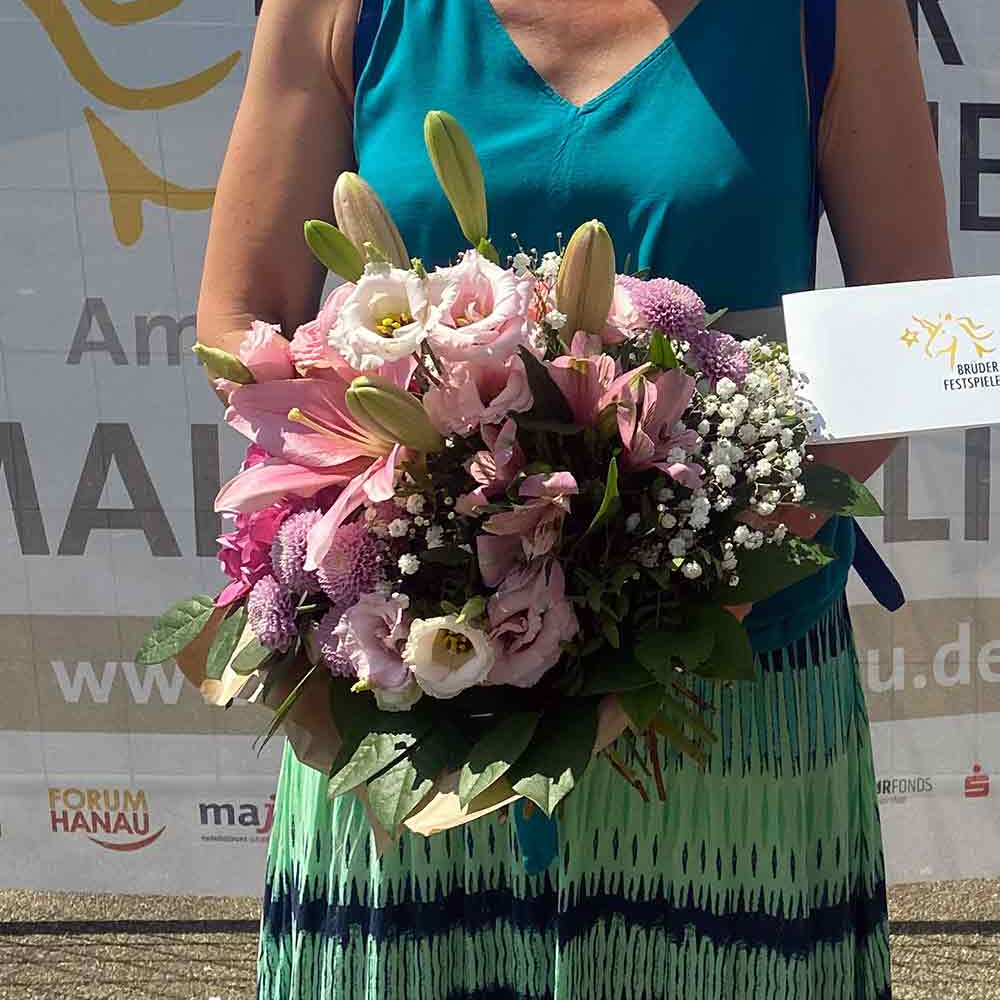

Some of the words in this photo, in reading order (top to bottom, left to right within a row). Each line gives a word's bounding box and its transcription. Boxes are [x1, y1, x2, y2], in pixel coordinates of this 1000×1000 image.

[943, 375, 1000, 391] FESTSPIELE
[48, 788, 148, 809] FORUM
[50, 809, 150, 835] HANAU
